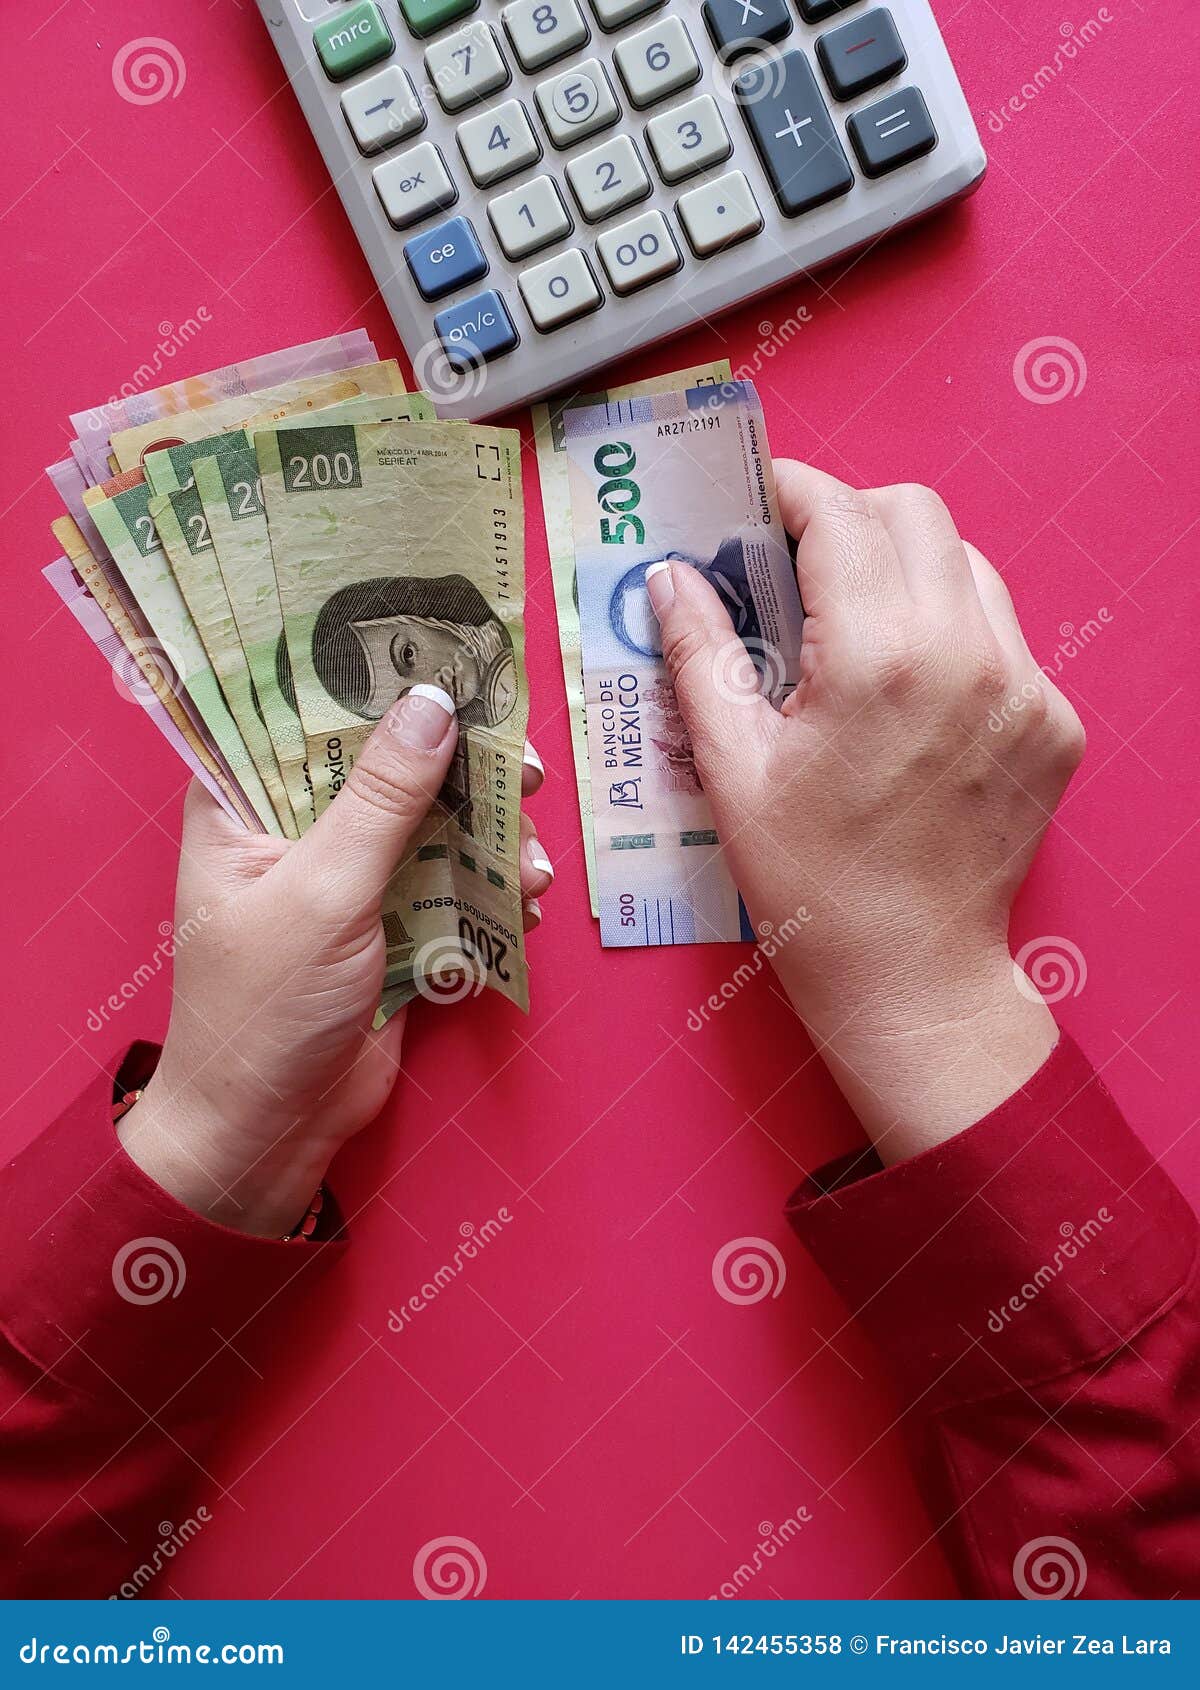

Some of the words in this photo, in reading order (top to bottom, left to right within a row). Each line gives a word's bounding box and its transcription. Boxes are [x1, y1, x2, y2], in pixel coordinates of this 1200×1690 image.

[328, 18, 372, 51] mrc
[532, 4, 558, 35] 8
[451, 45, 472, 76] 7
[645, 42, 671, 71] 6
[563, 82, 590, 114] 5
[487, 124, 512, 152] 4
[677, 120, 702, 149] 3
[399, 171, 426, 193] ex
[595, 162, 621, 191] 2
[517, 203, 536, 228] 1
[429, 242, 456, 264] ce
[449, 311, 495, 342] on/c
[657, 416, 720, 437] AR2712191
[748, 419, 759, 454] Pesos
[289, 452, 354, 488] 200
[594, 441, 645, 544] 500
[754, 458, 771, 525] Quinientos
[600, 680, 614, 701] DE
[617, 674, 643, 767] MÉXICO
[602, 708, 617, 767] BANCO
[325, 737, 344, 800] éxico
[412, 896, 462, 912] Pesos
[620, 893, 636, 927] 500
[463, 902, 518, 948] Doscientos
[458, 916, 511, 982] 200
